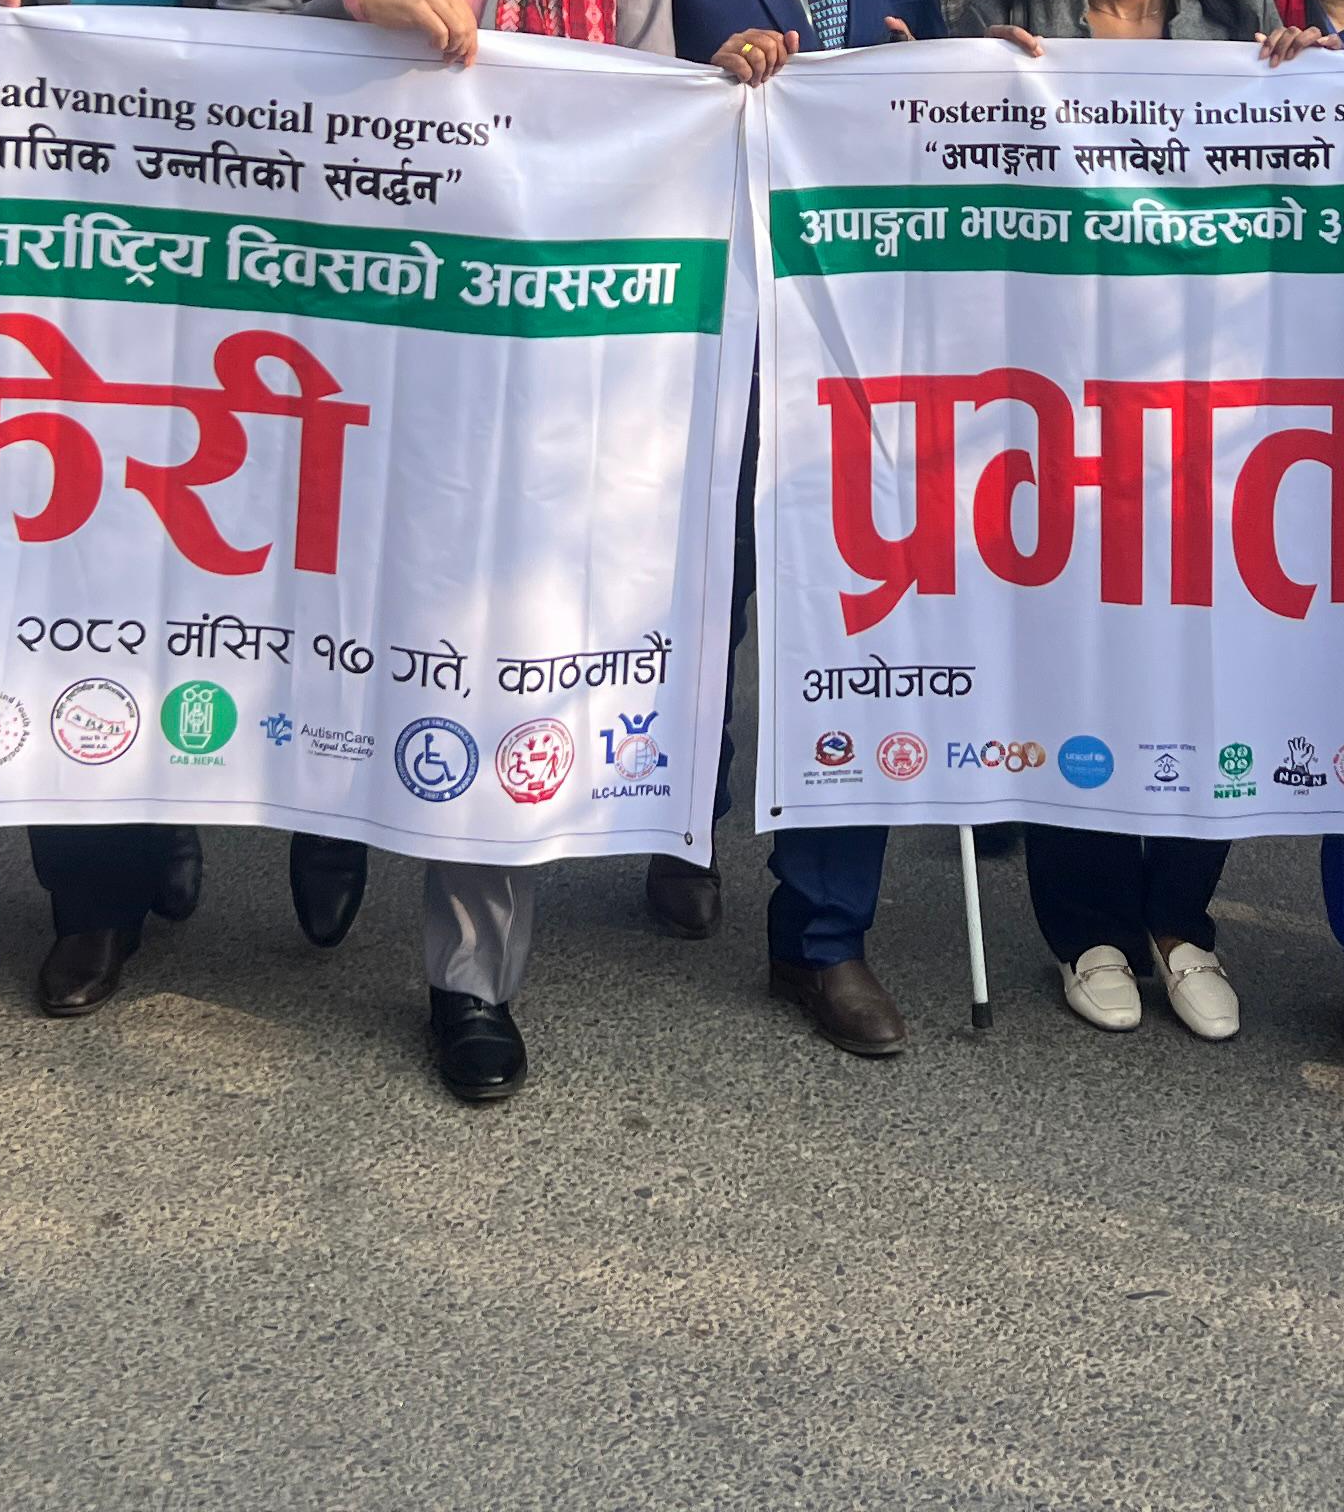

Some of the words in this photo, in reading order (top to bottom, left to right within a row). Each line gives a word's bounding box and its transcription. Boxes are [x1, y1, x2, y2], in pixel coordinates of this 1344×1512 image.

[0, 79, 197, 130] advancing
[207, 99, 313, 135] social
[1055, 99, 1184, 132] disability
[1195, 99, 1326, 126] inclusive
[136, 141, 305, 193] उन्नतिको
[1073, 138, 1191, 175] समावेशी
[1205, 136, 1335, 172] समाजको
[800, 205, 949, 257] अपाङ्गता
[961, 204, 1073, 244] भएका
[227, 224, 444, 301] दिवसको
[459, 258, 681, 312] अवसरमा
[16, 615, 146, 656] २०८२
[166, 612, 295, 665] मंसिर
[312, 633, 374, 675] १७
[802, 654, 976, 703] आयोजक
[591, 785, 671, 800] ILC-LALITPUR
[1213, 789, 1257, 800] NFD-N
[1278, 771, 1323, 786] NDFN
